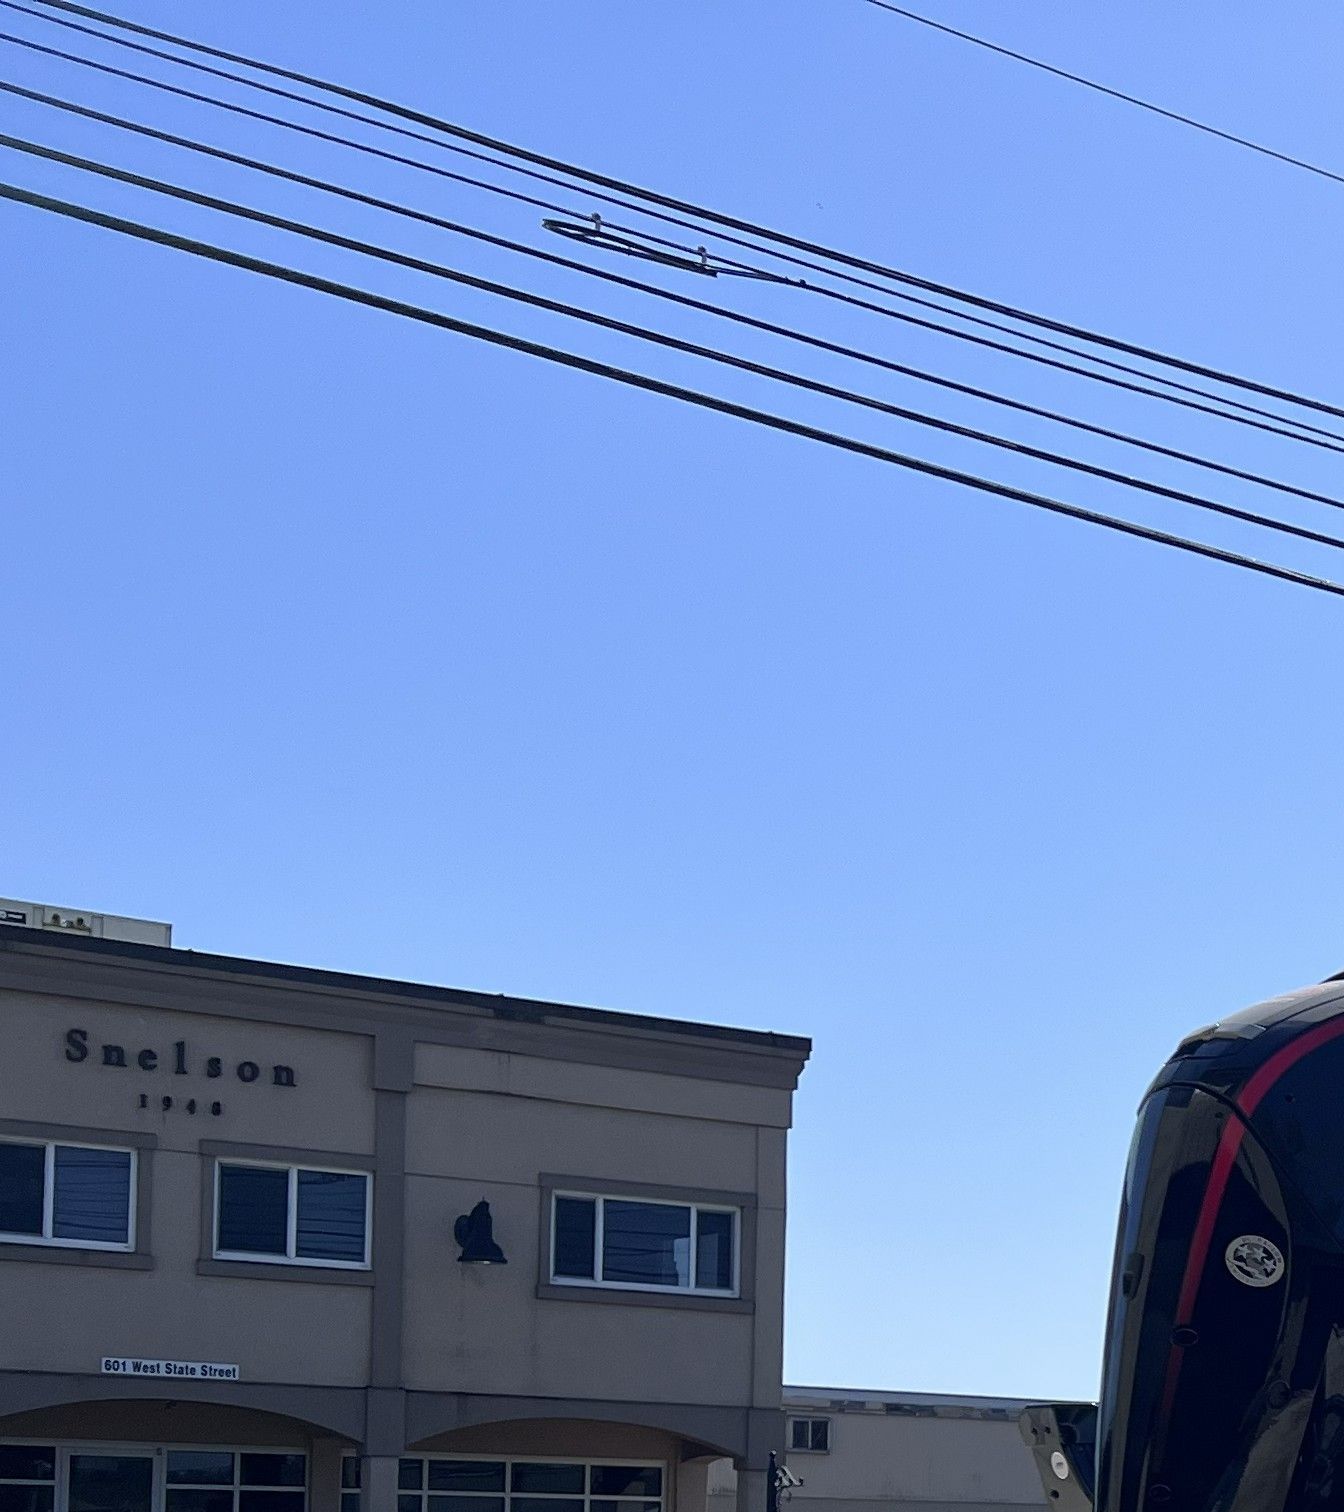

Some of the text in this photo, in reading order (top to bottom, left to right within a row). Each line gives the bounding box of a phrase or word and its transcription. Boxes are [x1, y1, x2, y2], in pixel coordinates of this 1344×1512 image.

[65, 1028, 297, 1087] Snelson
[104, 1359, 237, 1379] 601 West State Street
